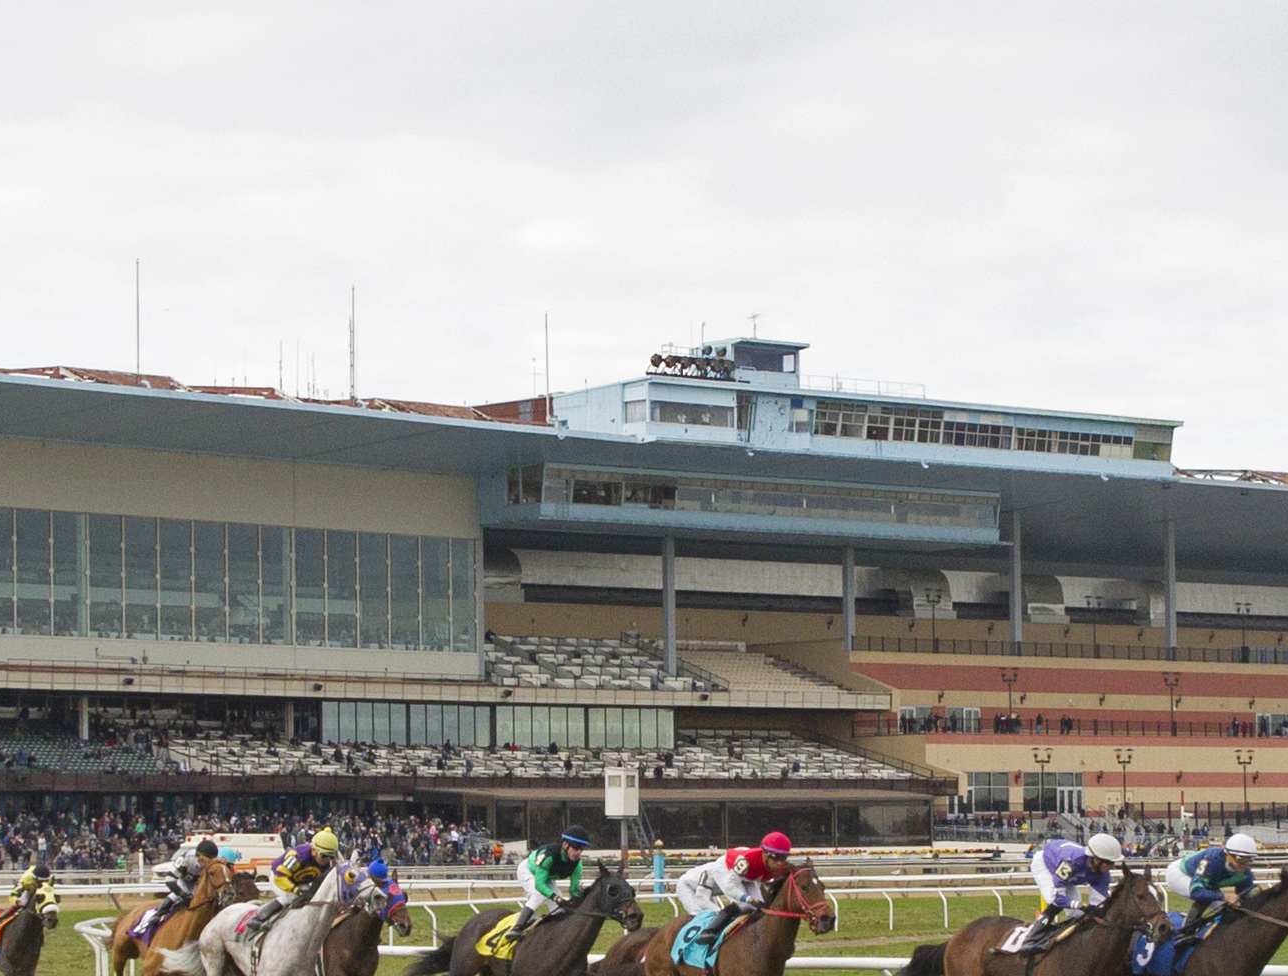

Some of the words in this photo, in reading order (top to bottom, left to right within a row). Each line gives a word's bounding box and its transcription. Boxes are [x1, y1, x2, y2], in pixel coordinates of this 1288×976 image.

[734, 858, 748, 875] 9
[1054, 860, 1073, 881] 13
[1197, 859, 1209, 876] 3
[1136, 934, 1155, 967] 3
